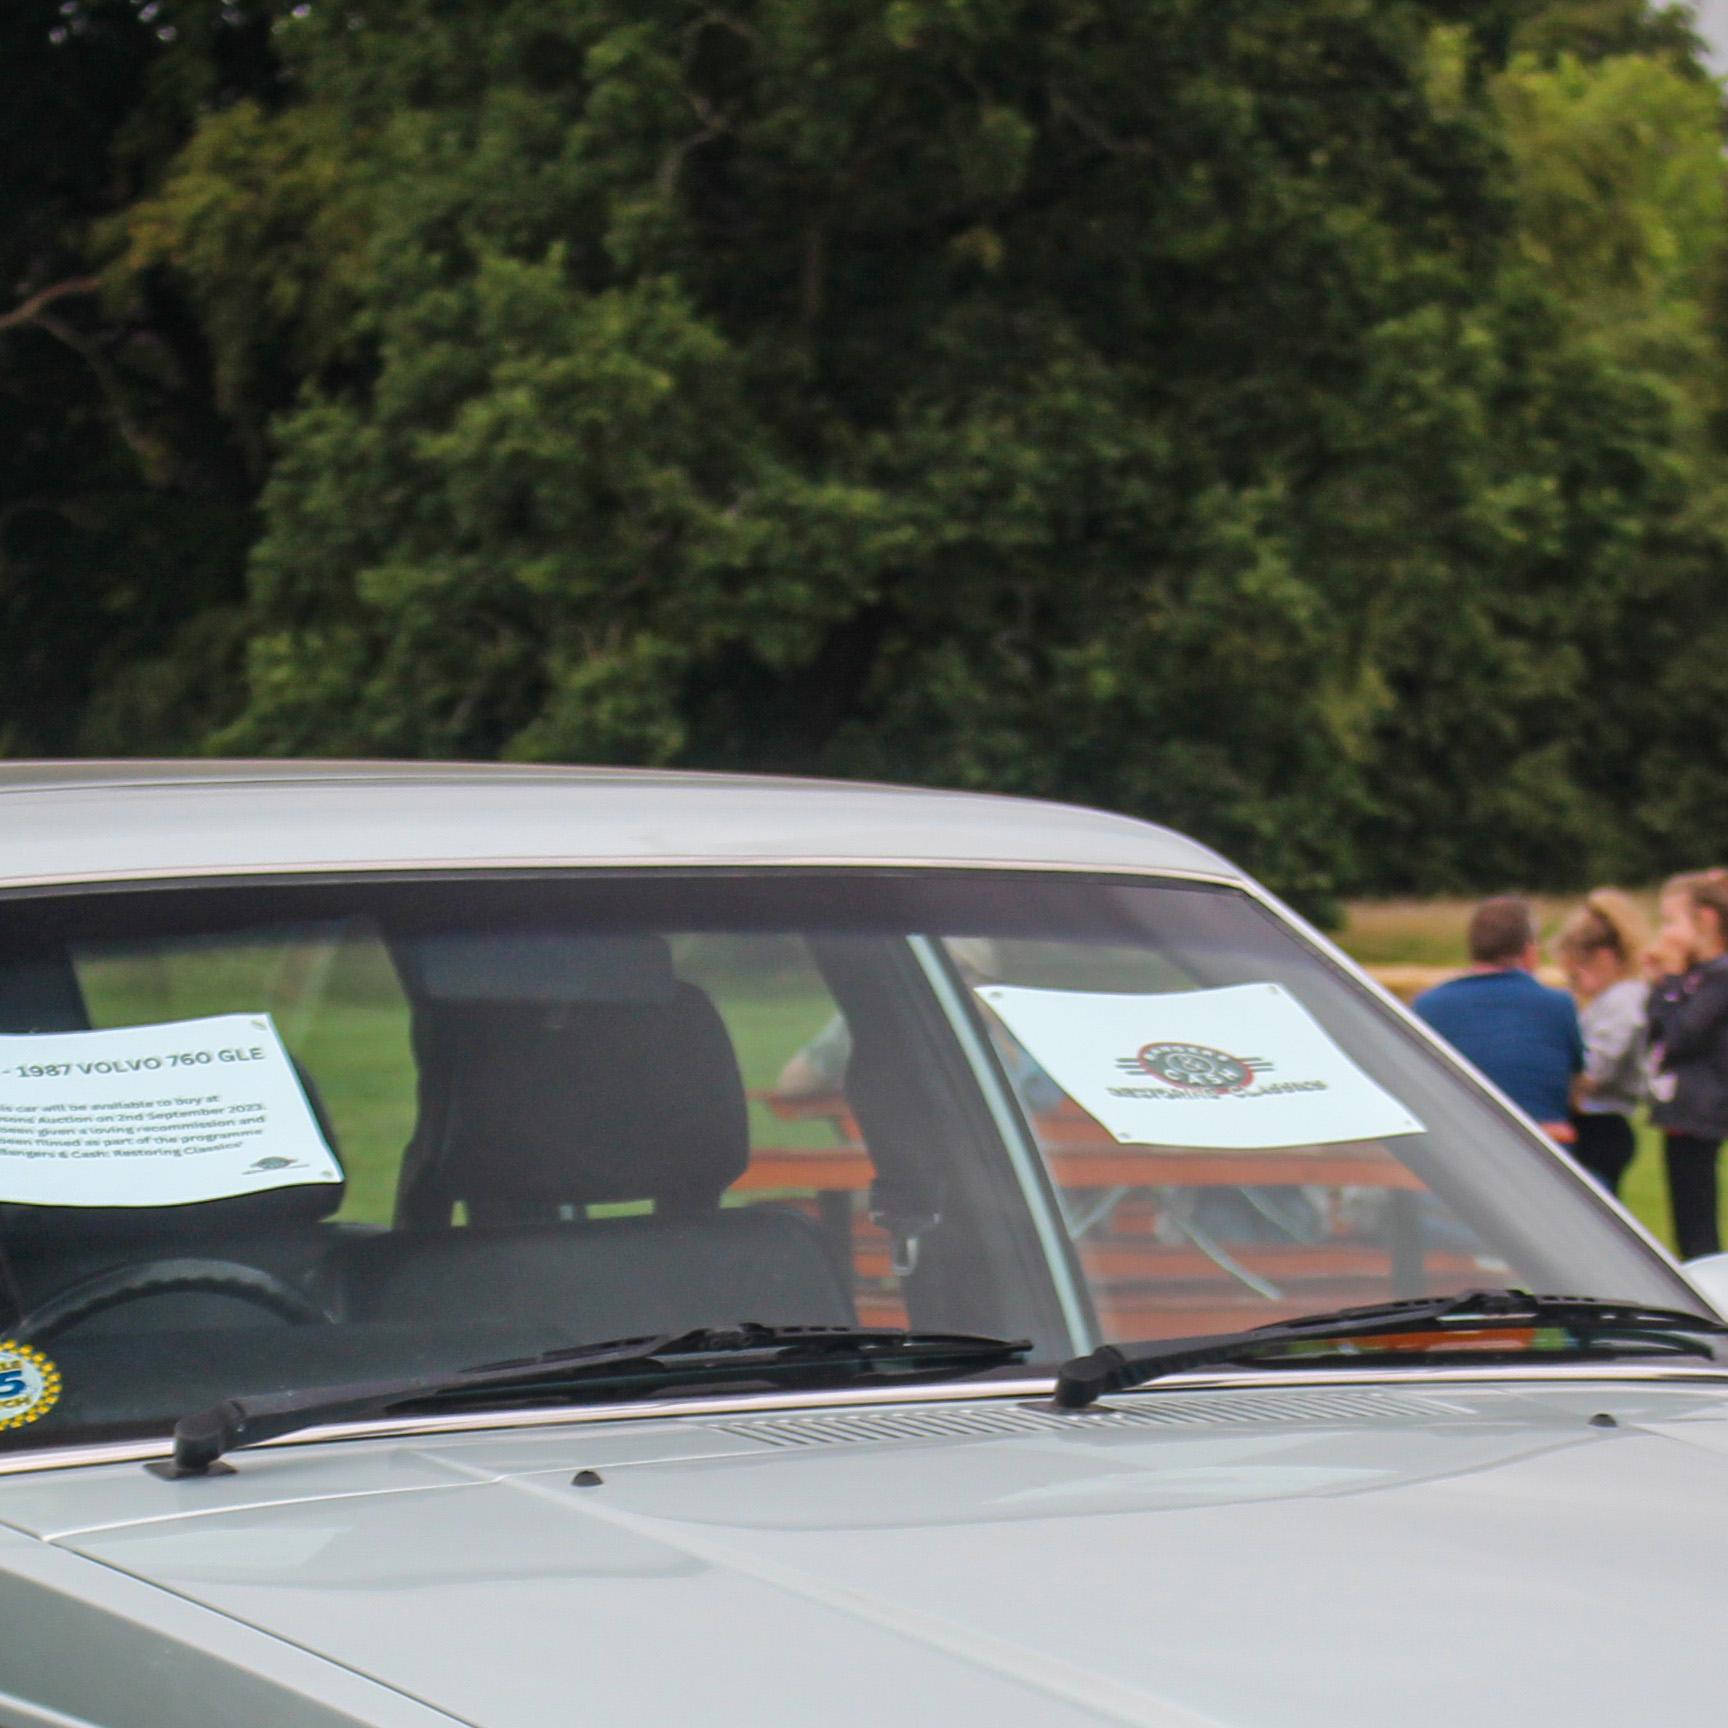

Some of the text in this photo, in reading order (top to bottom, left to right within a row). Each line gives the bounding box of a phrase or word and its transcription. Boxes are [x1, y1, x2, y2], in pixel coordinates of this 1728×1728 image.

[17, 1062, 72, 1078] 1987
[75, 1056, 163, 1076] VOLVO
[165, 1050, 213, 1068] 760
[218, 1047, 267, 1063] GLE
[69, 1103, 87, 1112] be
[90, 1099, 154, 1111] available
[156, 1098, 173, 1107] to
[173, 1096, 202, 1108] buy
[37, 1114, 93, 1124] Auction
[96, 1115, 115, 1123] on
[117, 1112, 145, 1122] 2nd
[145, 1106, 225, 1120] September
[137, 1120, 235, 1133] recommission
[238, 1115, 266, 1125] and
[102, 1136, 134, 1147] part
[152, 1134, 179, 1144] the
[180, 1128, 265, 1144] programme
[112, 1147, 183, 1159] Restoring
